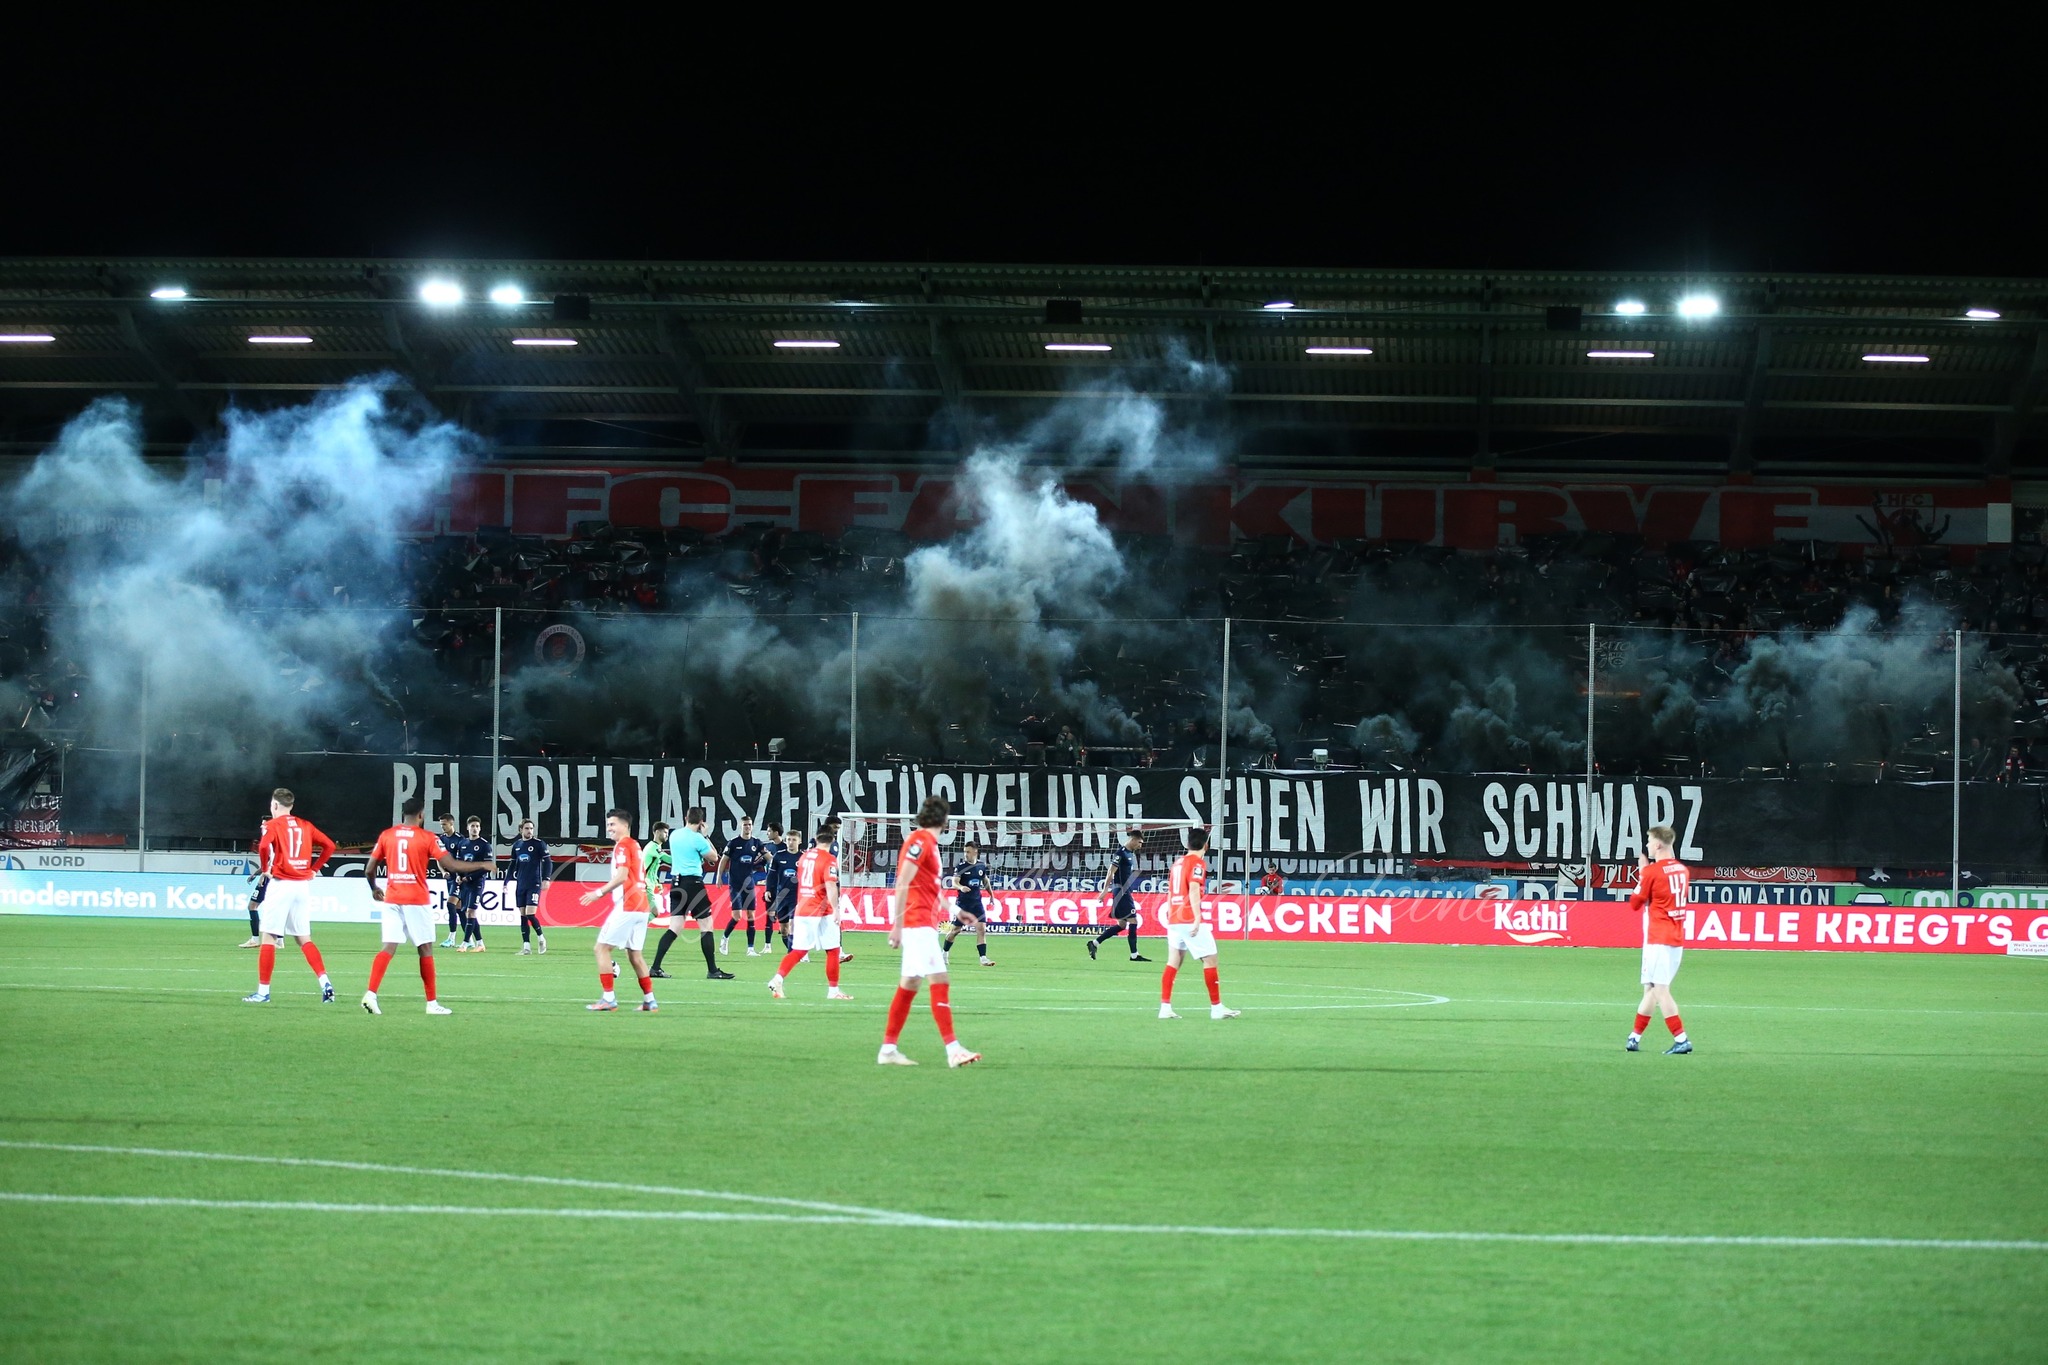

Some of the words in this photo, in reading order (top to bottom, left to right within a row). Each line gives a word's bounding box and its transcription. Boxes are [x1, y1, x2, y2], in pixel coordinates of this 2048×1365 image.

[1179, 775, 1326, 853] SEHEN
[1358, 778, 1447, 854] WIR
[1482, 781, 1704, 862] SCHWARZ
[287, 827, 303, 858] 17
[398, 838, 409, 872] 6
[39, 855, 85, 867] NORD
[213, 858, 244, 866] NORD
[1783, 865, 1818, 882] 1984
[0, 881, 156, 909] modernsten
[1668, 873, 1687, 908] 42
[1688, 885, 1830, 905] UTOMATION
[1010, 924, 1072, 934] SPIELBANK
[1494, 902, 1568, 931] Kathi
[1683, 909, 1800, 942] HALLE
